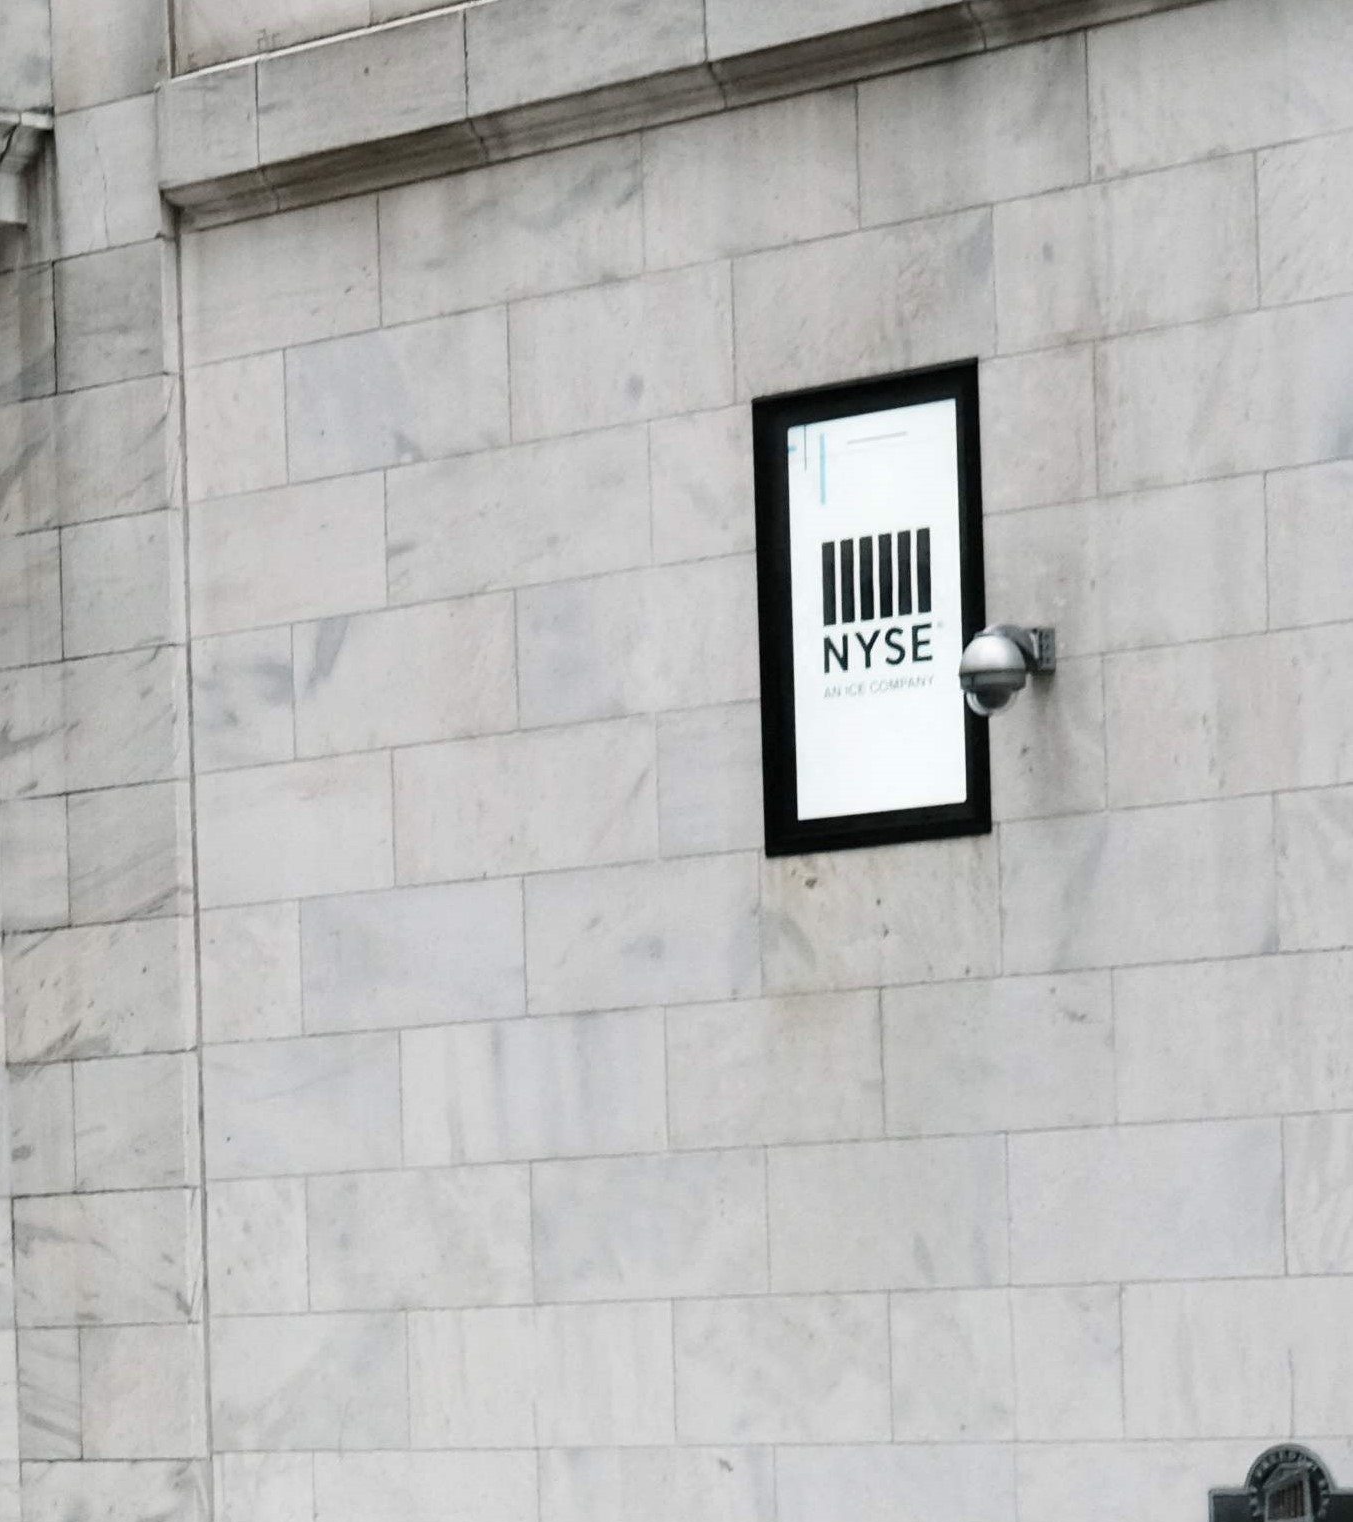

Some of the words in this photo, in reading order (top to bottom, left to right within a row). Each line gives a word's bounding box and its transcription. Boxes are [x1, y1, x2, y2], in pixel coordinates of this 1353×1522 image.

[823, 623, 933, 674] NYSE
[823, 685, 841, 699] AN
[845, 682, 866, 697] ICE
[869, 674, 935, 694] COMPANY
